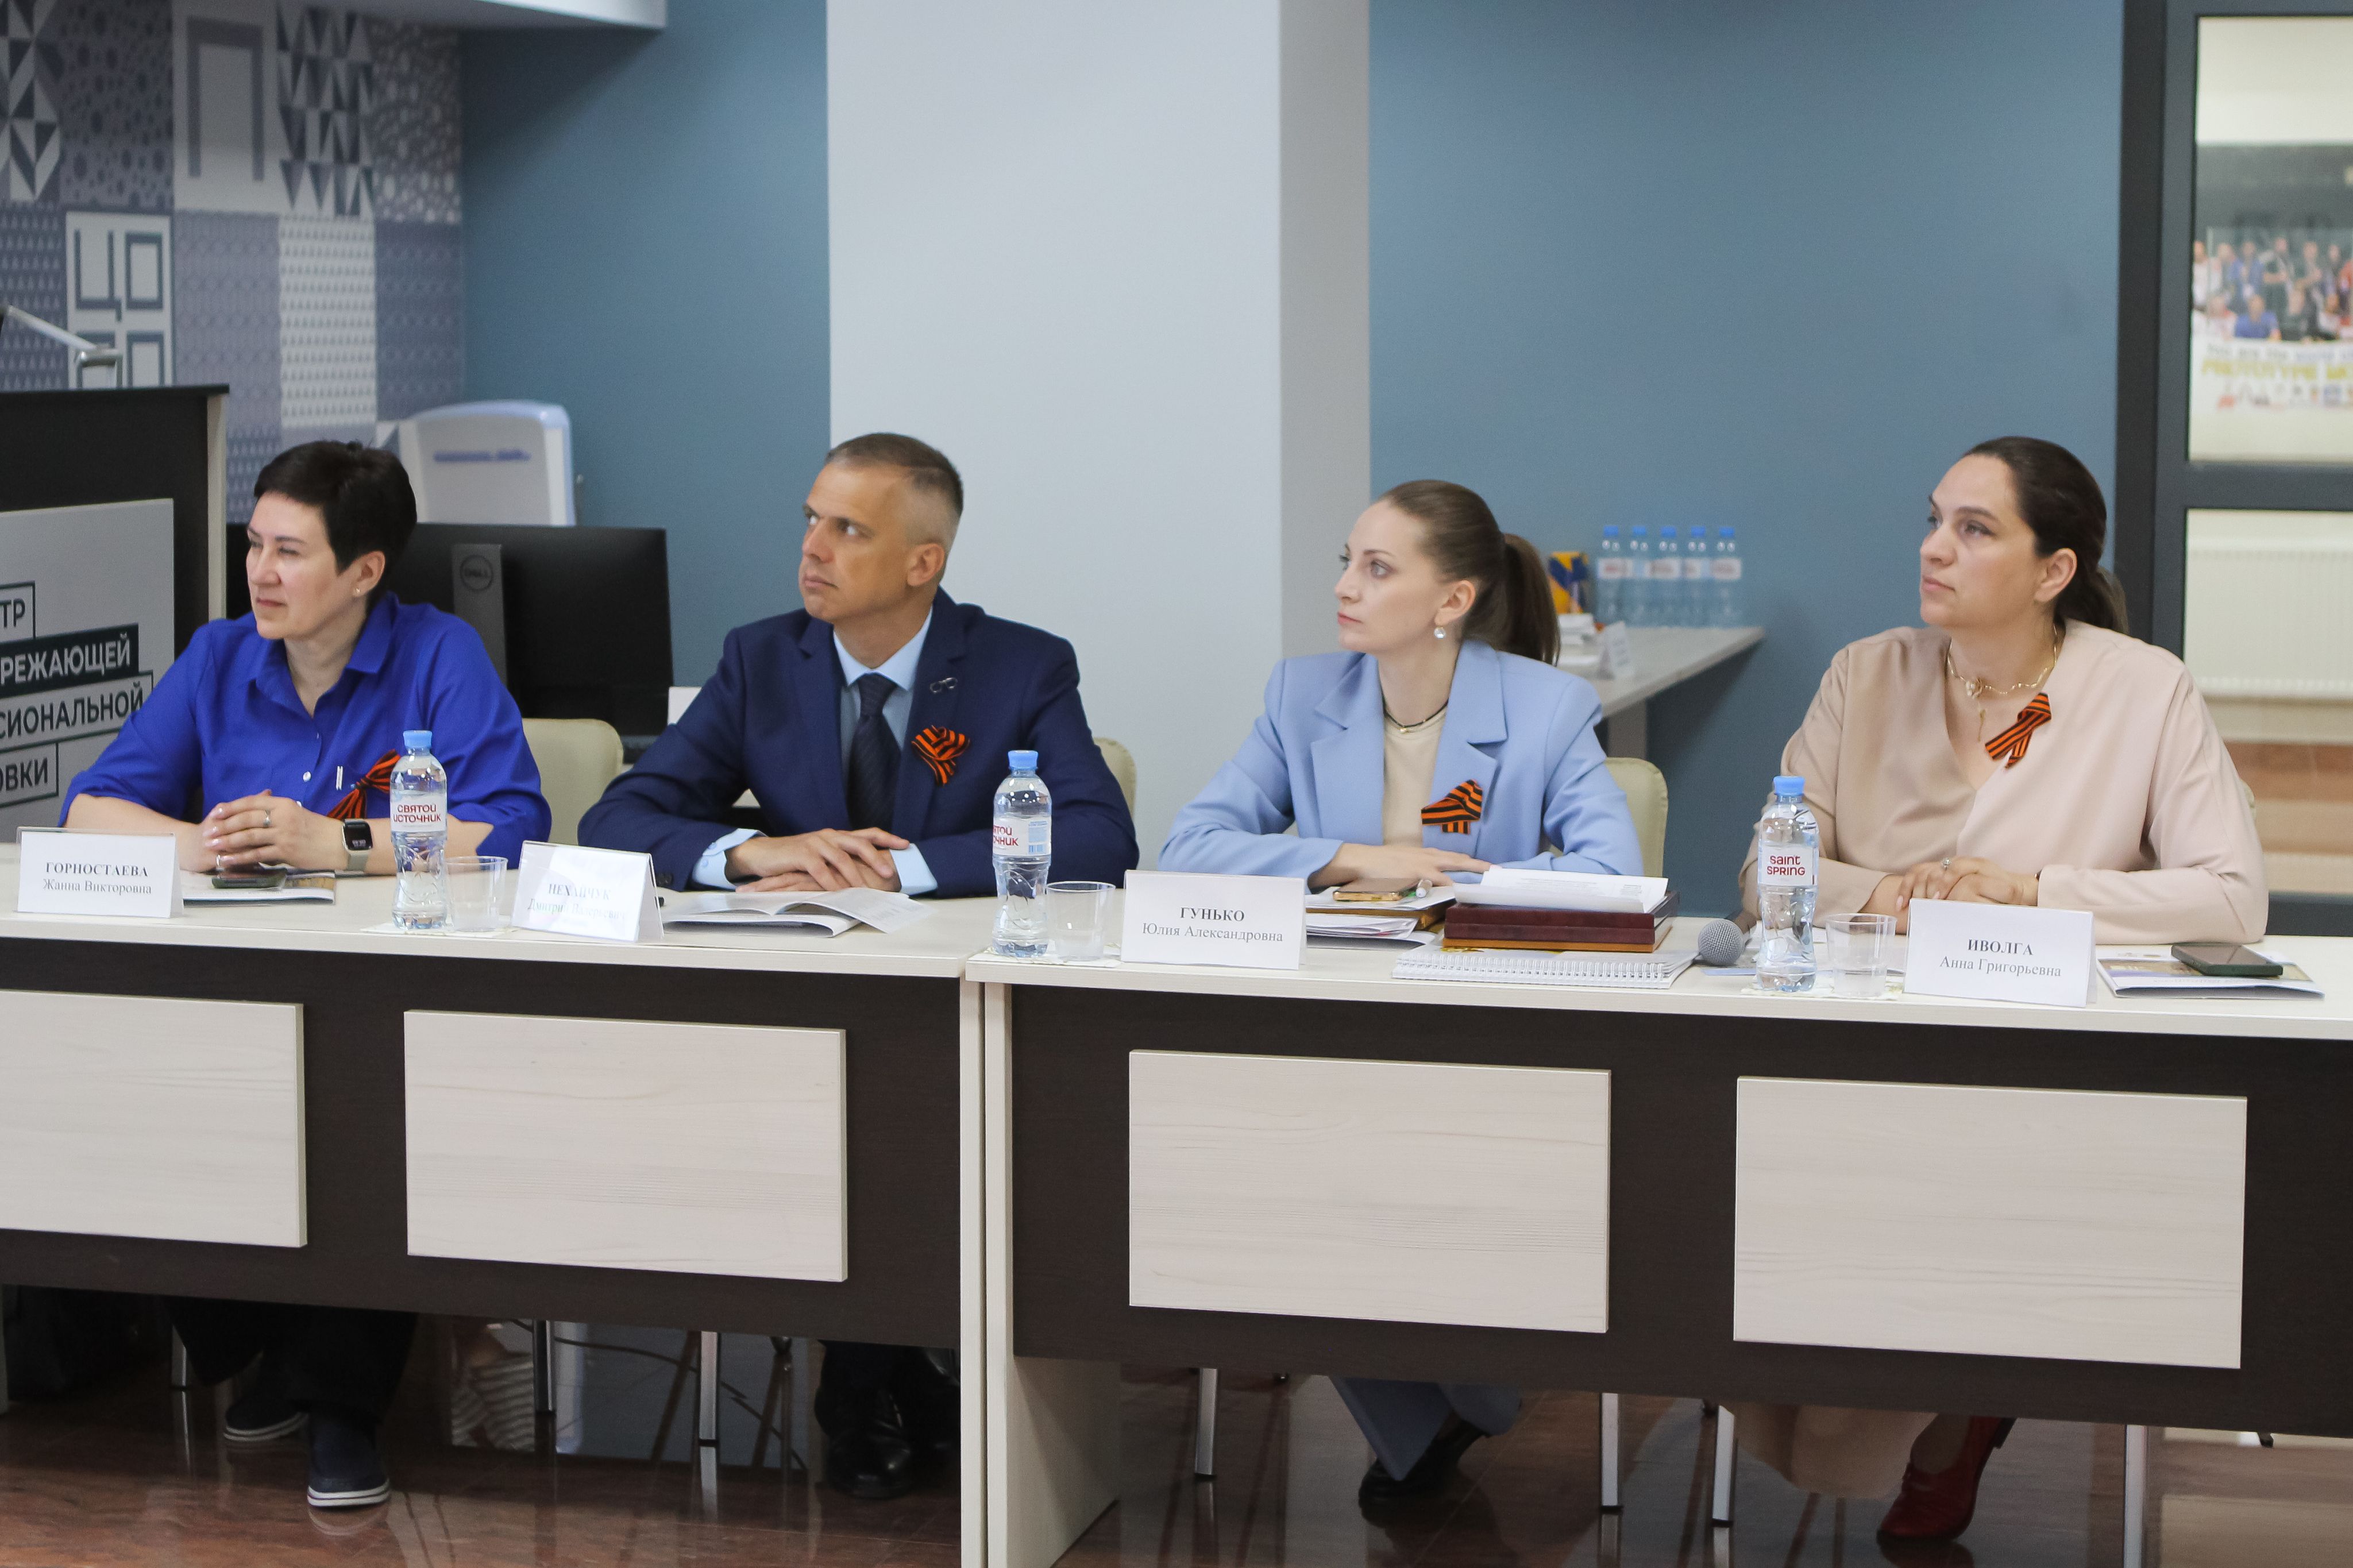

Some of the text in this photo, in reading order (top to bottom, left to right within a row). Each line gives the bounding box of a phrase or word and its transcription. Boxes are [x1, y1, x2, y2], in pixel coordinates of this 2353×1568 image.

[0, 757, 48, 792] ВКИ
[394, 813, 441, 822] ИСТОЧНИК
[45, 862, 148, 877] ГОРНОСТАЕВА
[43, 878, 152, 895] Жанна Викторовна
[1179, 906, 1245, 922] ГУНЬКО
[1142, 922, 1283, 943] Юлия Александровна
[1967, 938, 2034, 956] ИВОЛГА
[1939, 955, 2062, 976] Анна Григорьевна
